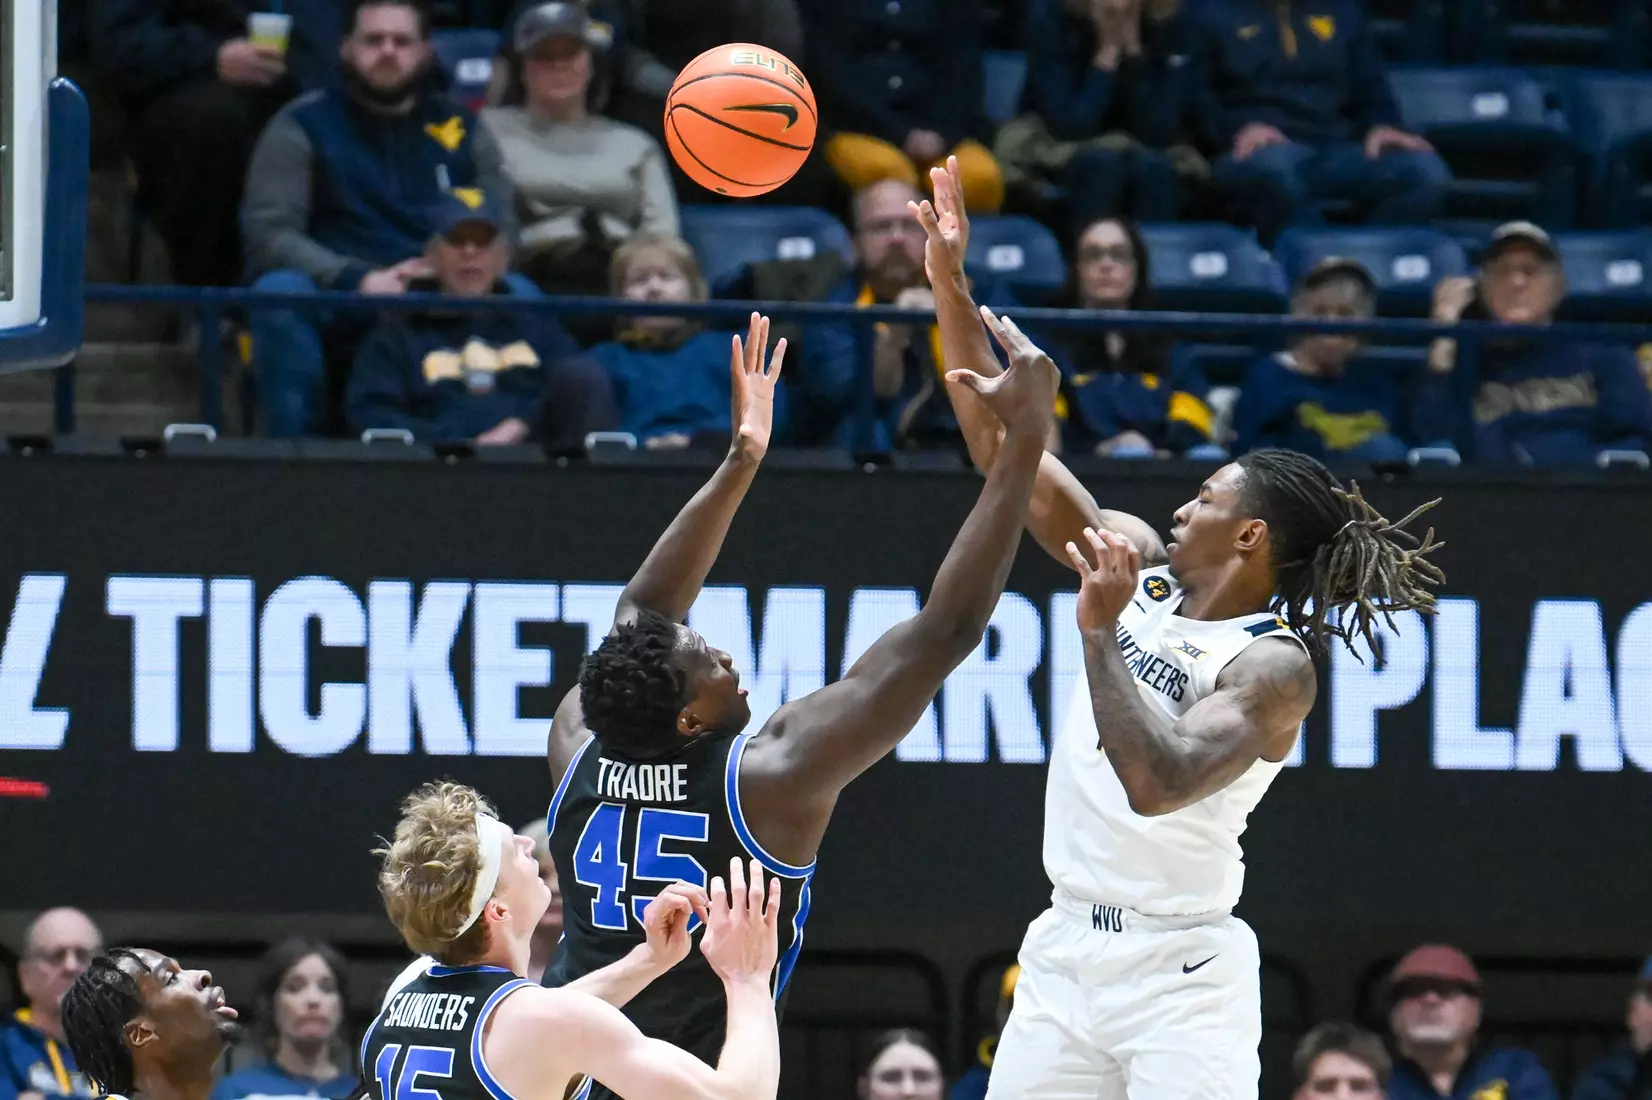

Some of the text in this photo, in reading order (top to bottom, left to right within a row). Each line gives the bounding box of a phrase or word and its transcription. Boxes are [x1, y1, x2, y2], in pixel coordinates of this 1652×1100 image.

[733, 52, 805, 90] ELITE
[597, 757, 688, 801] TRAORE
[573, 800, 709, 933] 45
[1092, 903, 1122, 933] WVU
[384, 992, 476, 1031] SAUNDERS
[374, 1043, 456, 1100] 15
